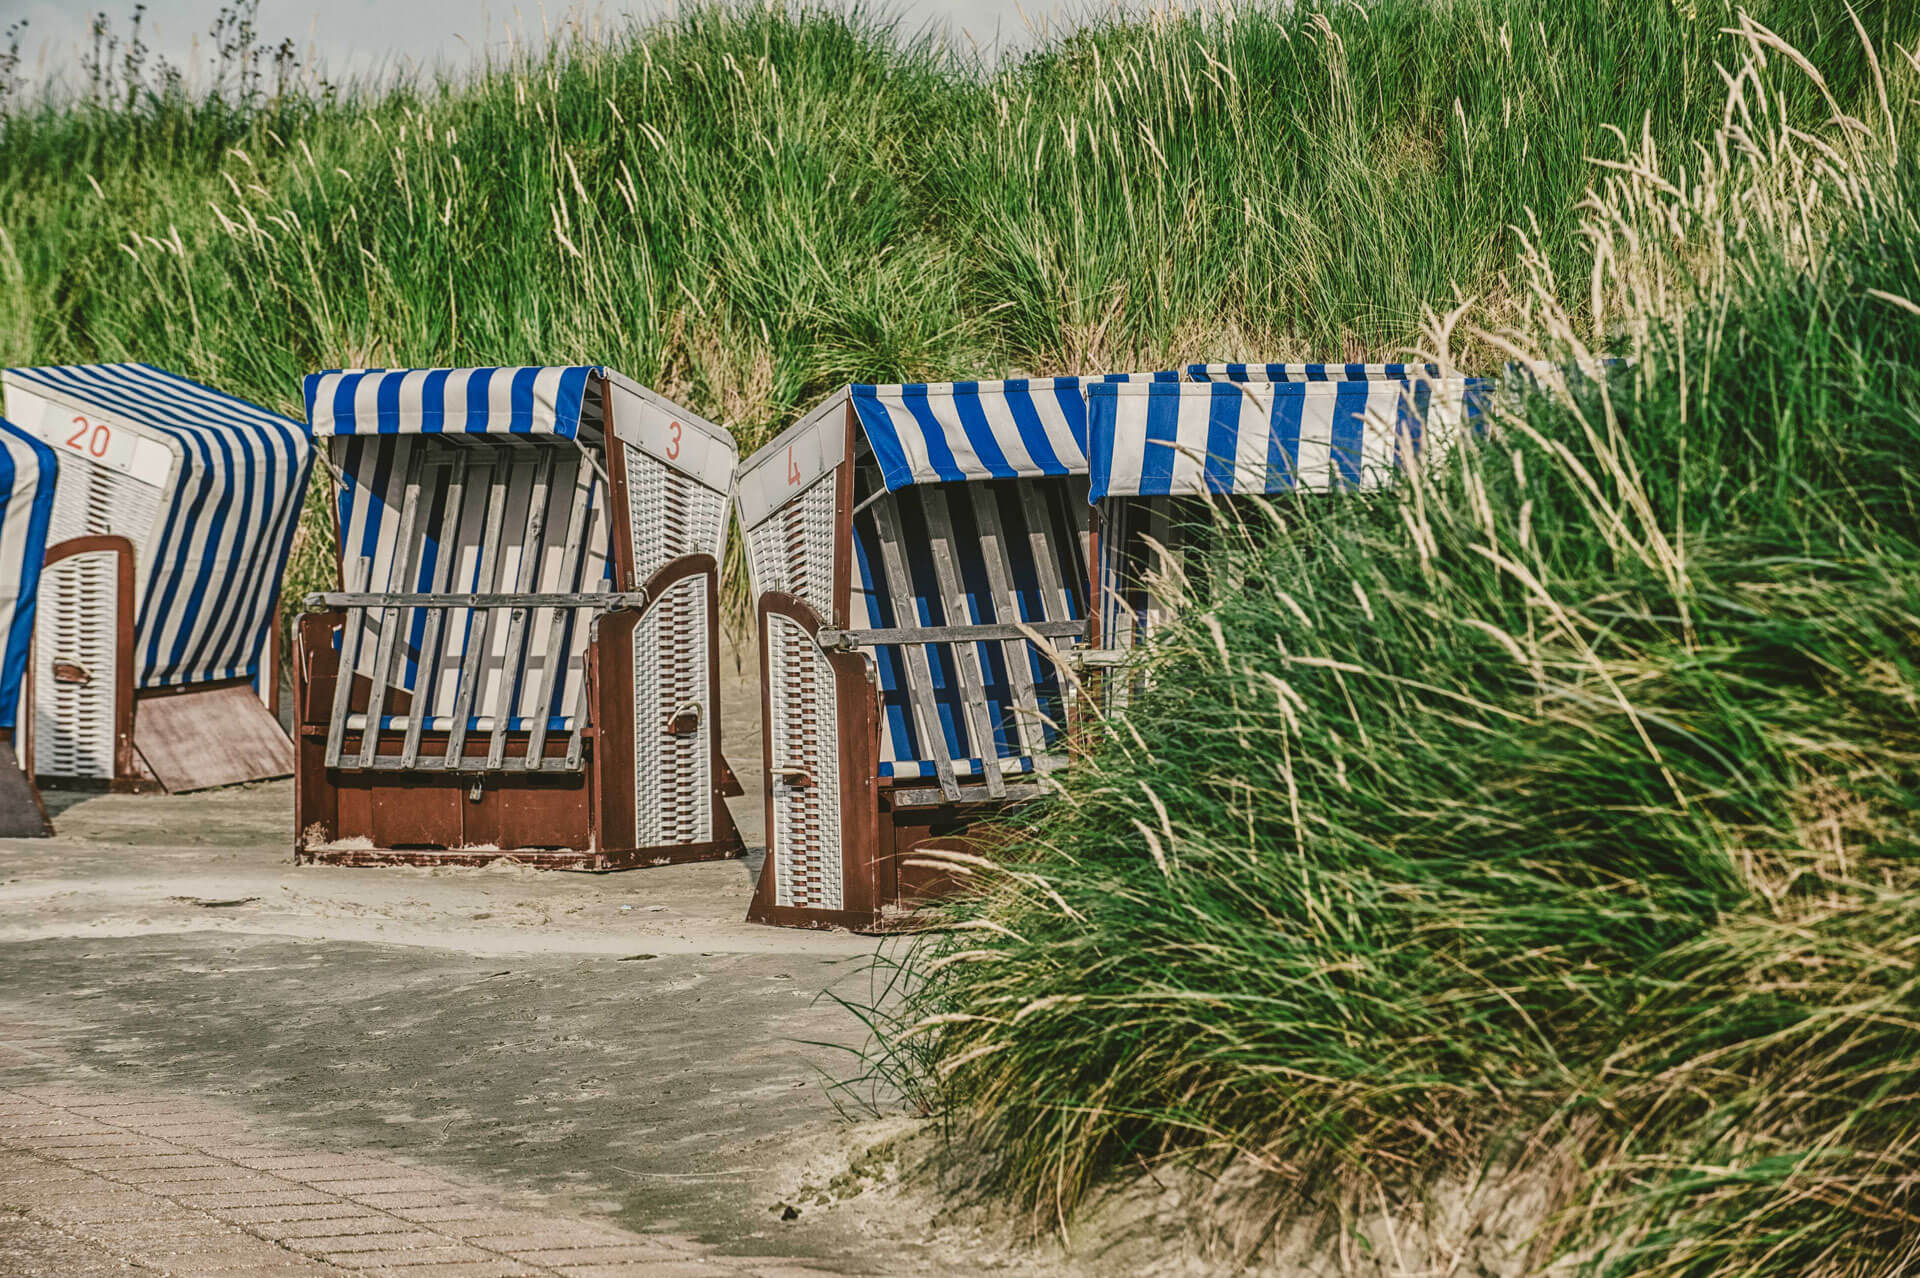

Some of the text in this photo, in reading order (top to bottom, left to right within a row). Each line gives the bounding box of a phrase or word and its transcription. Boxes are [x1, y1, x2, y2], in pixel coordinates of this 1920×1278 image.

[66, 416, 110, 457] 20
[666, 421, 682, 460] 3
[787, 445, 801, 486] 4
